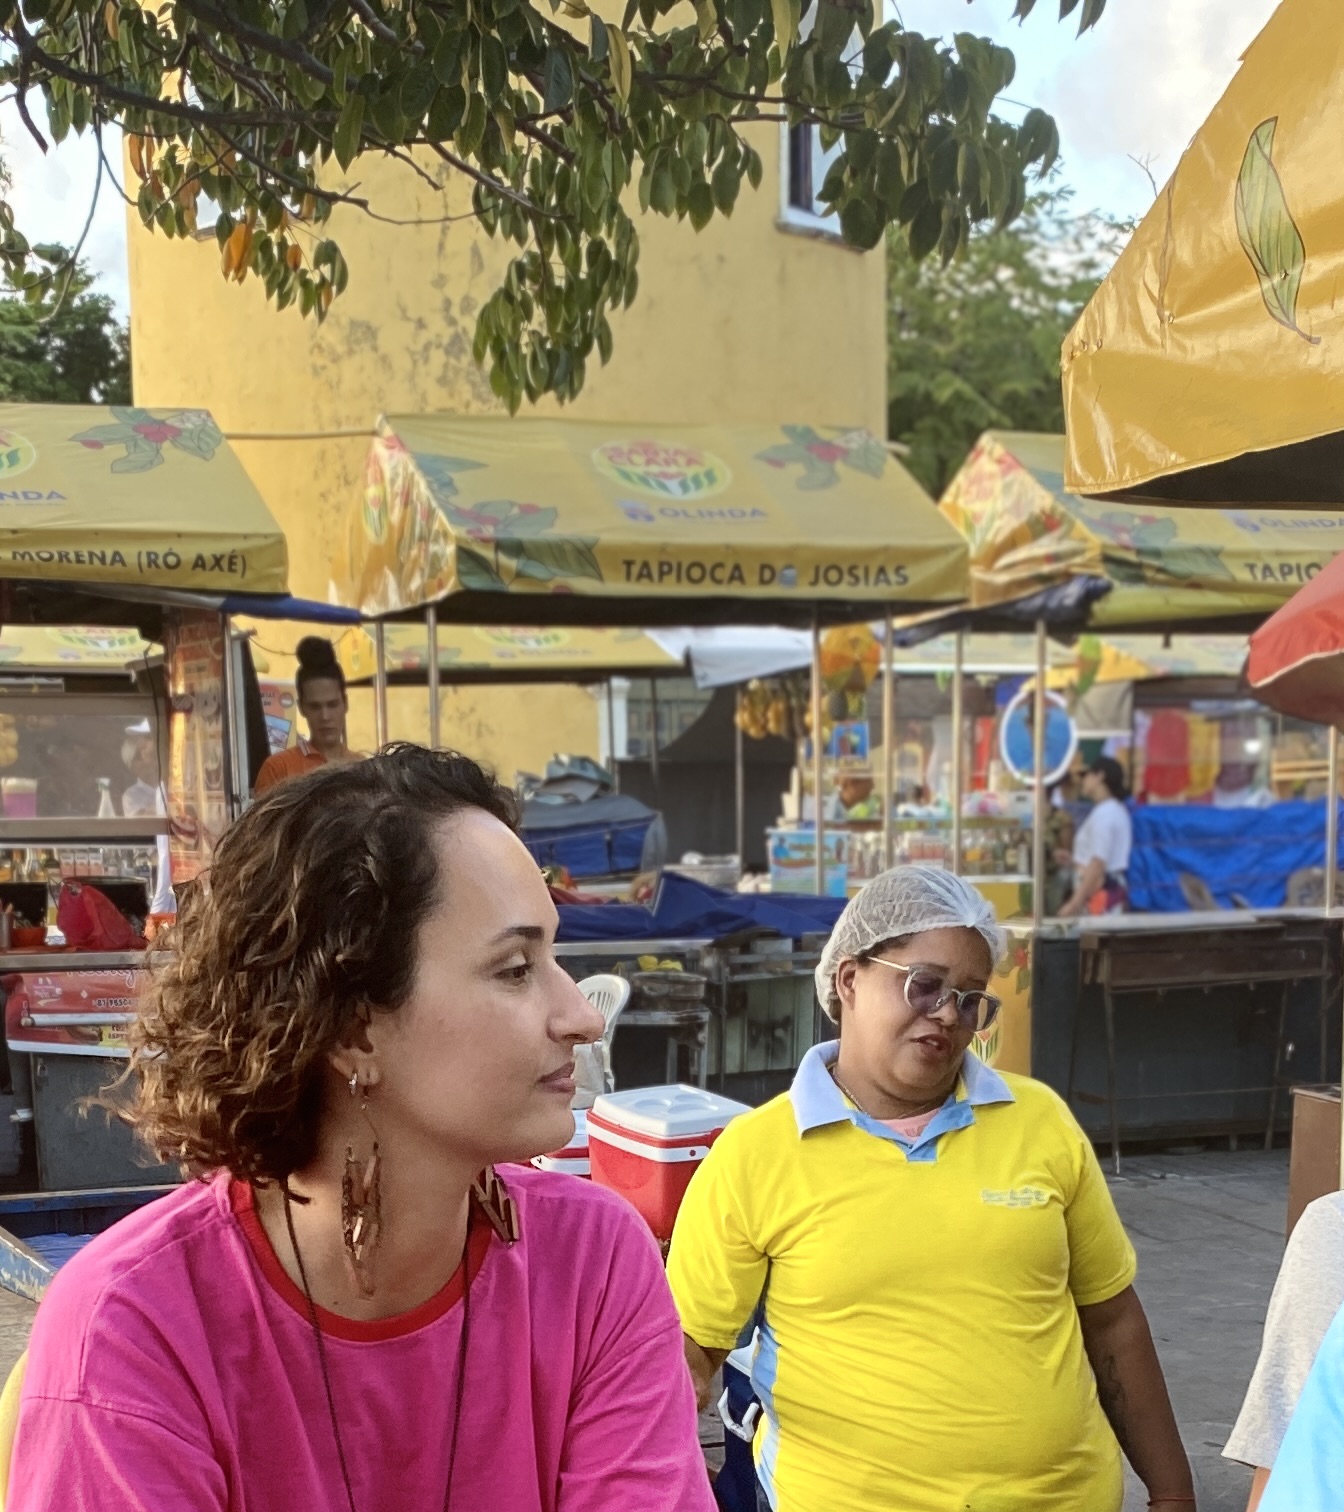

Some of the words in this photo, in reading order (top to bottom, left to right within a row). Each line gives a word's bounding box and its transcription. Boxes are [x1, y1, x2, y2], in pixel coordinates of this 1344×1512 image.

[659, 506, 768, 519] OLINDA
[12, 550, 127, 568] MORENA
[137, 547, 182, 574] (RÓ
[191, 549, 247, 578] AXÉ)
[622, 559, 746, 586] TAPIOCA
[808, 564, 909, 588] JOSIAS
